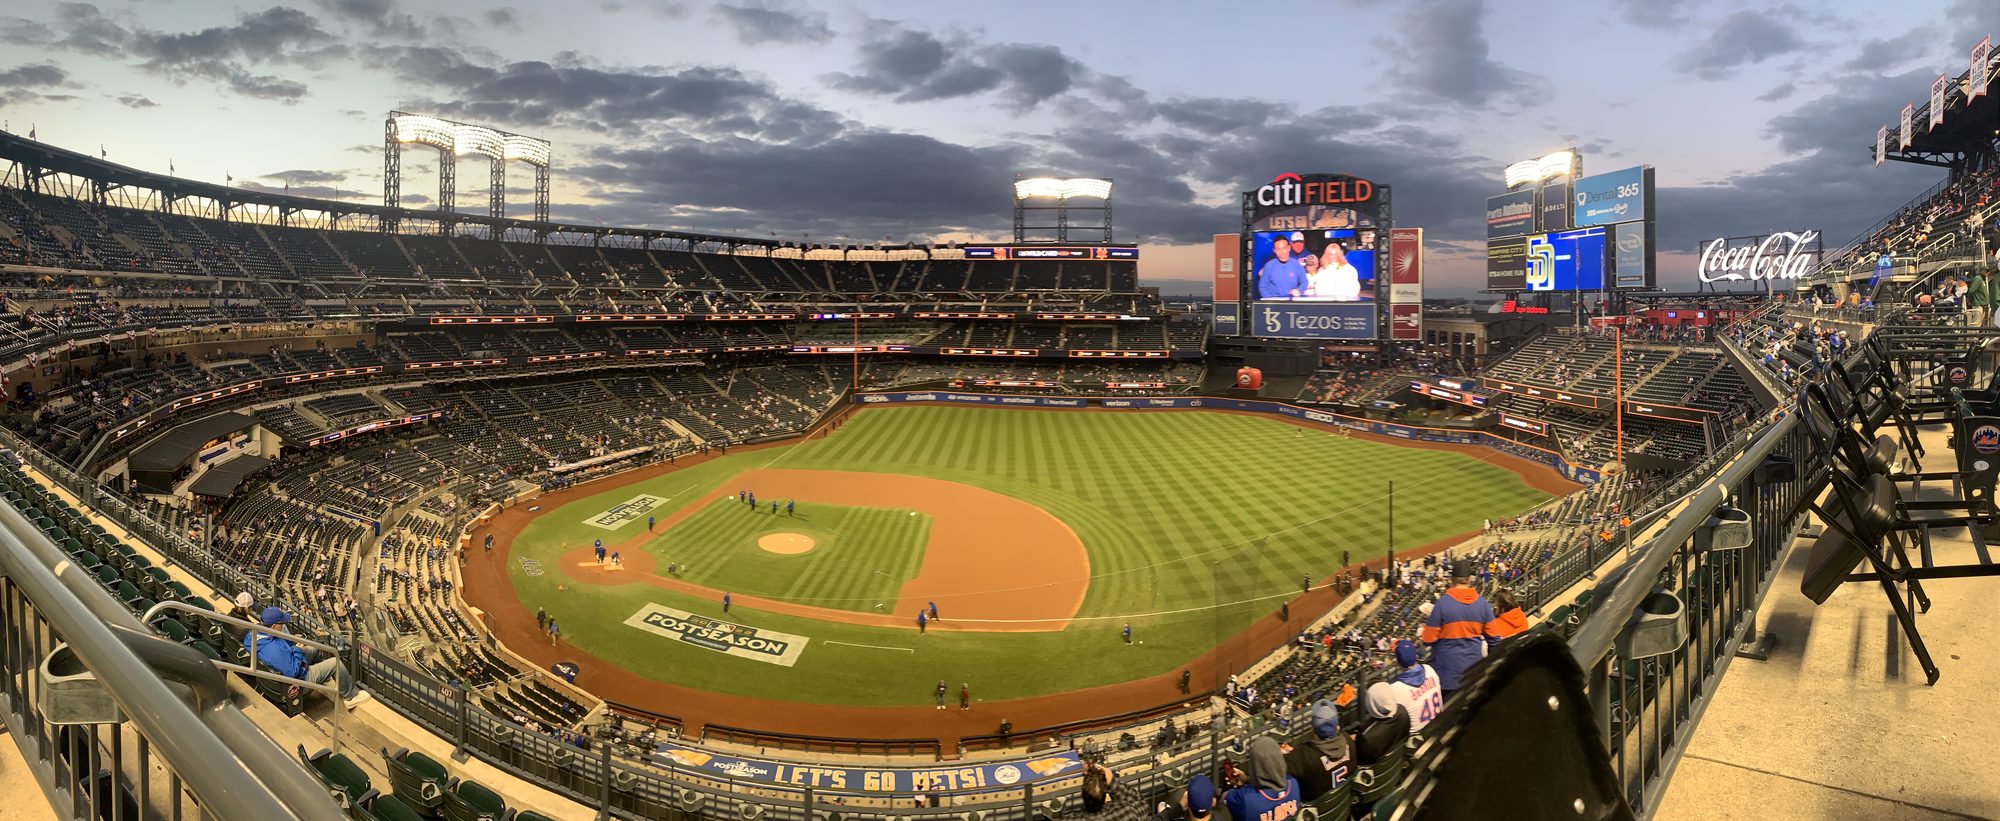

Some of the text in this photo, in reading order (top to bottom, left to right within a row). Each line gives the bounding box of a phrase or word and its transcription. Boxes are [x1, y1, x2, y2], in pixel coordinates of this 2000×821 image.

[1257, 178, 1372, 206] citi FIELD
[1699, 230, 1819, 282] Coca-Cola
[1285, 311, 1341, 330] Tezos
[1305, 411, 1334, 423] GEICO
[648, 614, 784, 654] POSTSEASON
[440, 687, 453, 698] 407
[1420, 691, 1440, 723] 48
[713, 761, 768, 775] POSTSEASON
[774, 766, 986, 792] LET'S GO METS!
